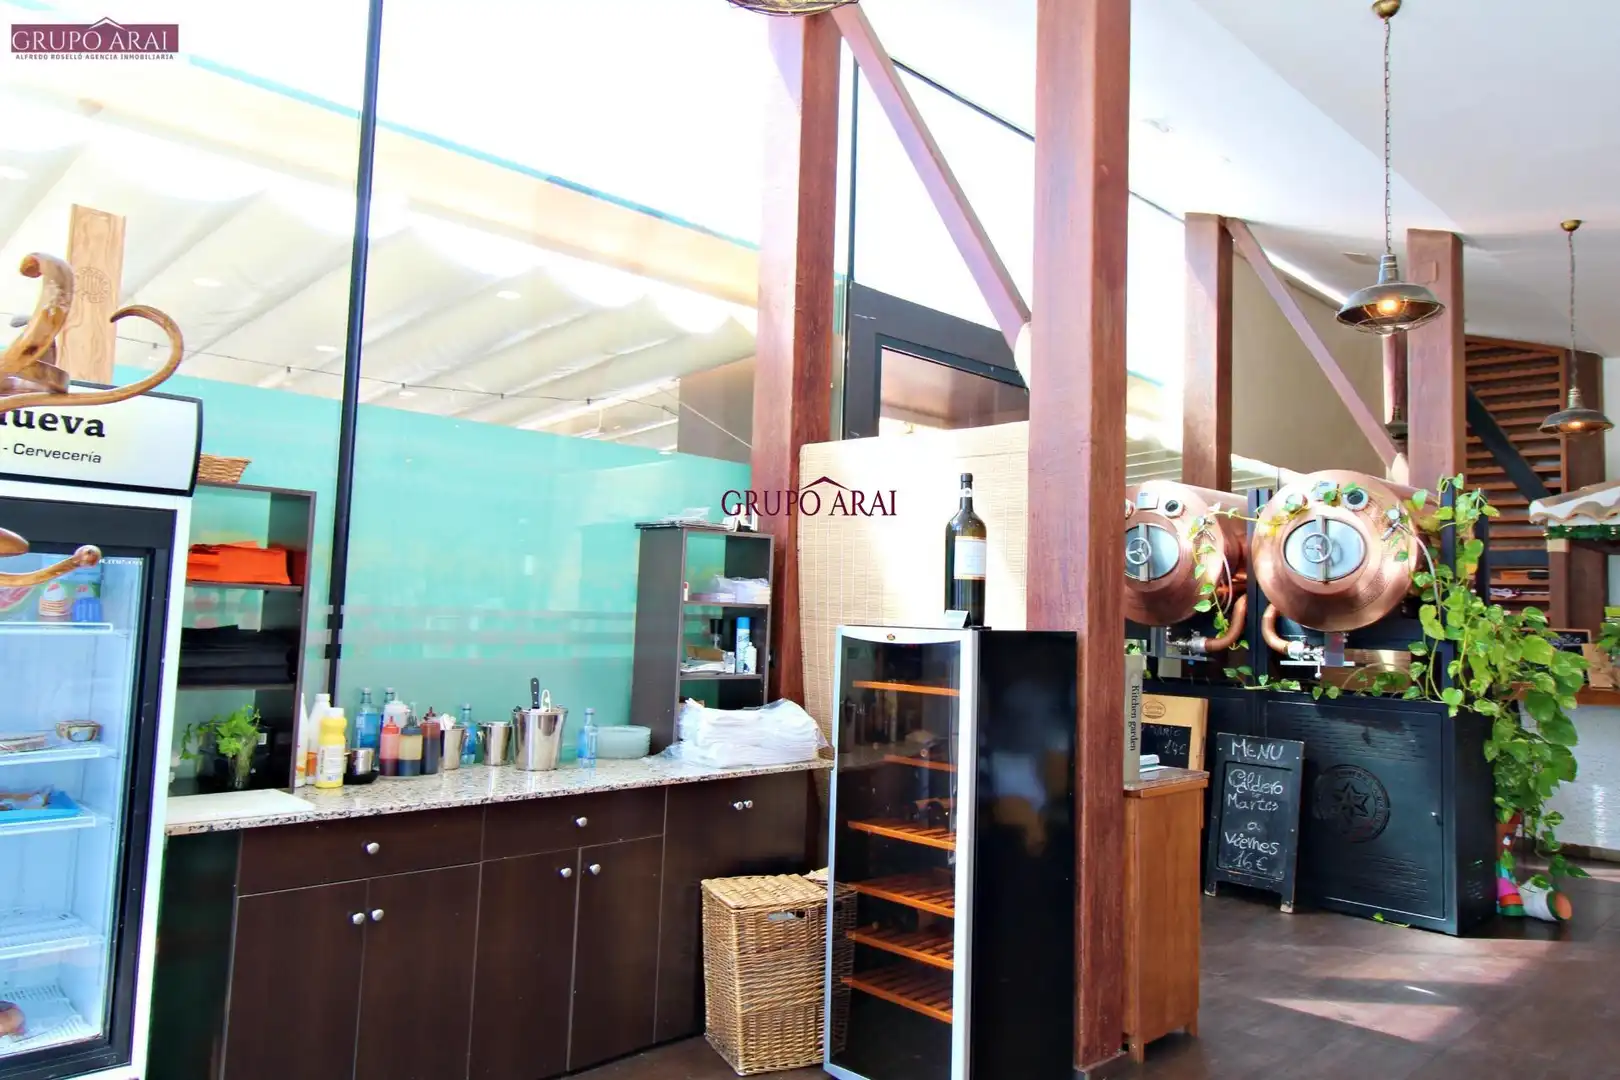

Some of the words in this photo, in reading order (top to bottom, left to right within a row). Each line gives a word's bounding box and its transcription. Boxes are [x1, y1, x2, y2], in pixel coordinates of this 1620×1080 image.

[13, 443, 102, 464] Cervecería
[1131, 685, 1140, 719] Kitchen
[1128, 721, 1139, 751] garden
[1231, 738, 1284, 761] MENU
[1228, 768, 1284, 795] Caldero
[1224, 831, 1280, 855] Viernes
